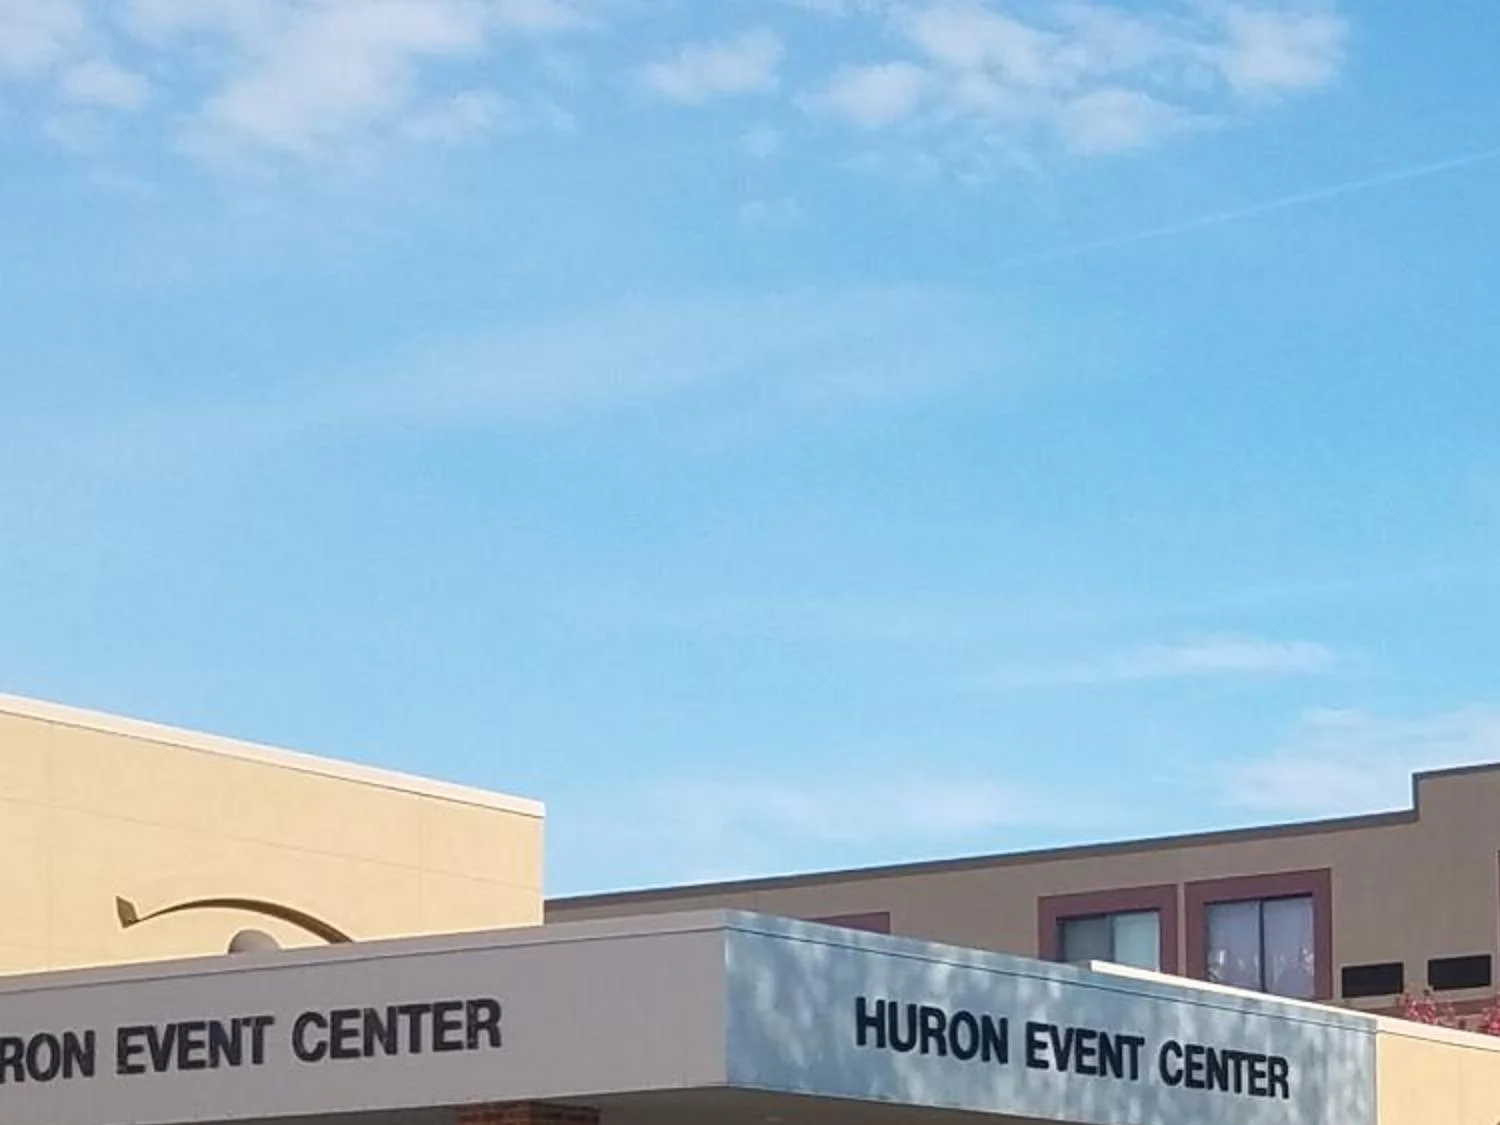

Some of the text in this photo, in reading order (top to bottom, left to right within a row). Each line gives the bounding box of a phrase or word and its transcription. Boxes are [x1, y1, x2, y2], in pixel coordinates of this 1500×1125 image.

[0, 998, 502, 1084] RON EVENT CENTER
[855, 996, 1290, 1099] HURON EVENT CENTER
